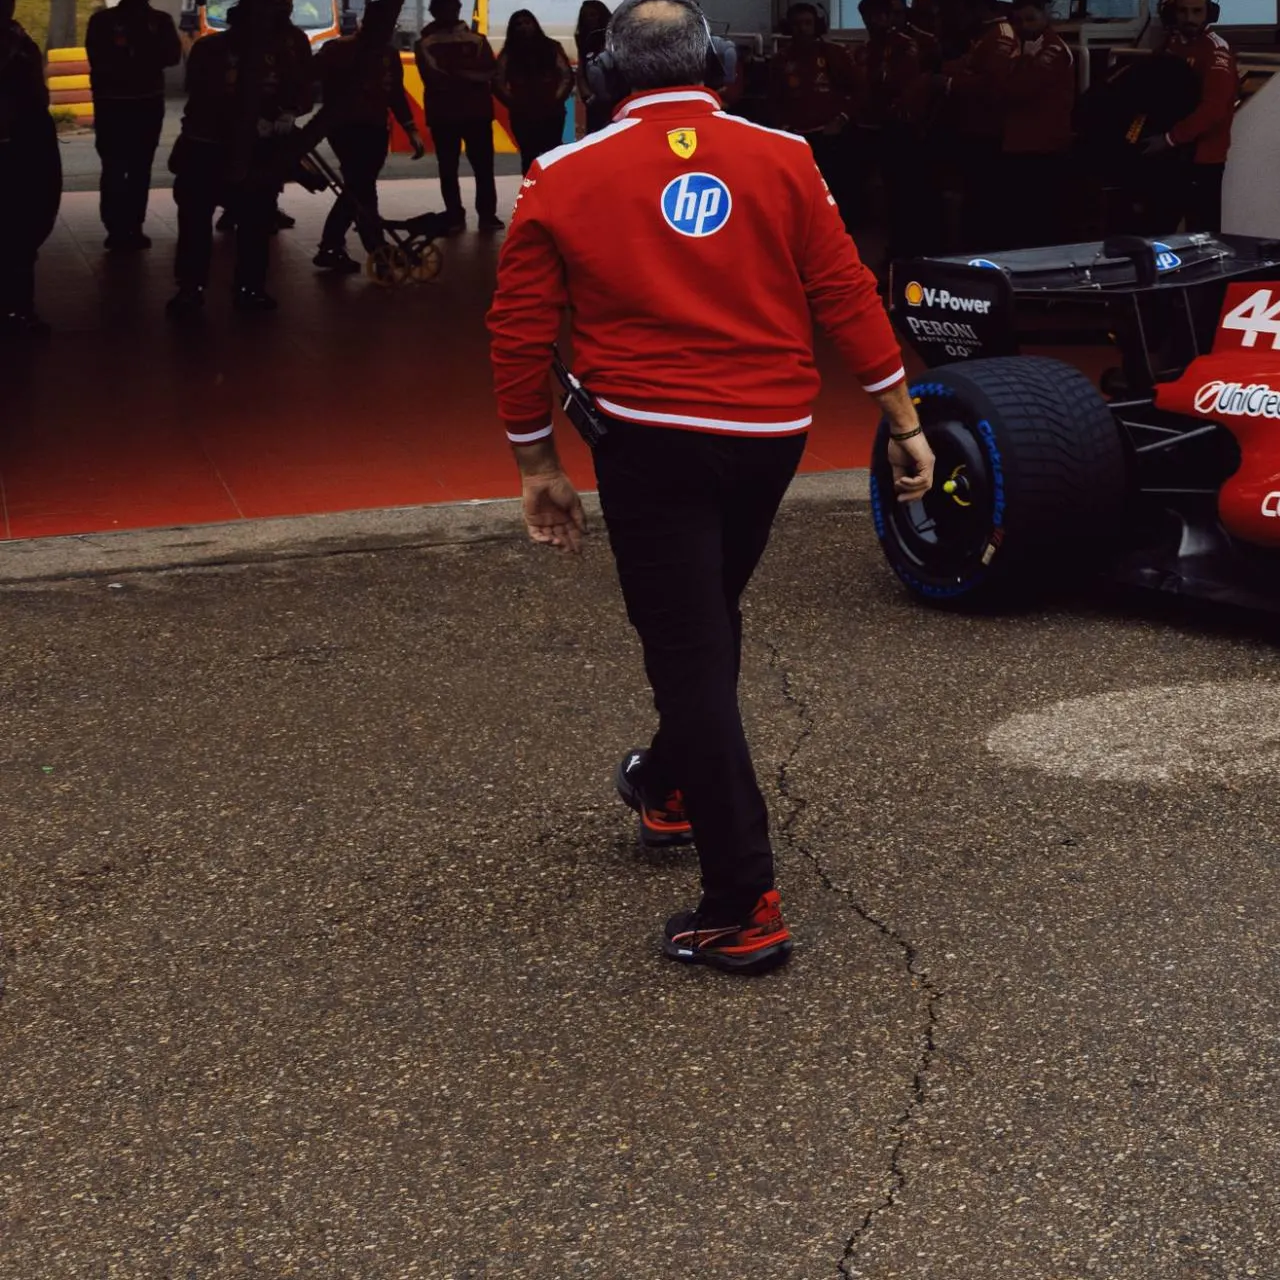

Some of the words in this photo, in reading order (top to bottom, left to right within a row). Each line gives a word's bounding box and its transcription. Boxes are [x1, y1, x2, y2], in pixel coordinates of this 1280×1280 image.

[672, 174, 722, 235] hp
[922, 287, 992, 314] V-Power
[906, 316, 978, 339] PERONI
